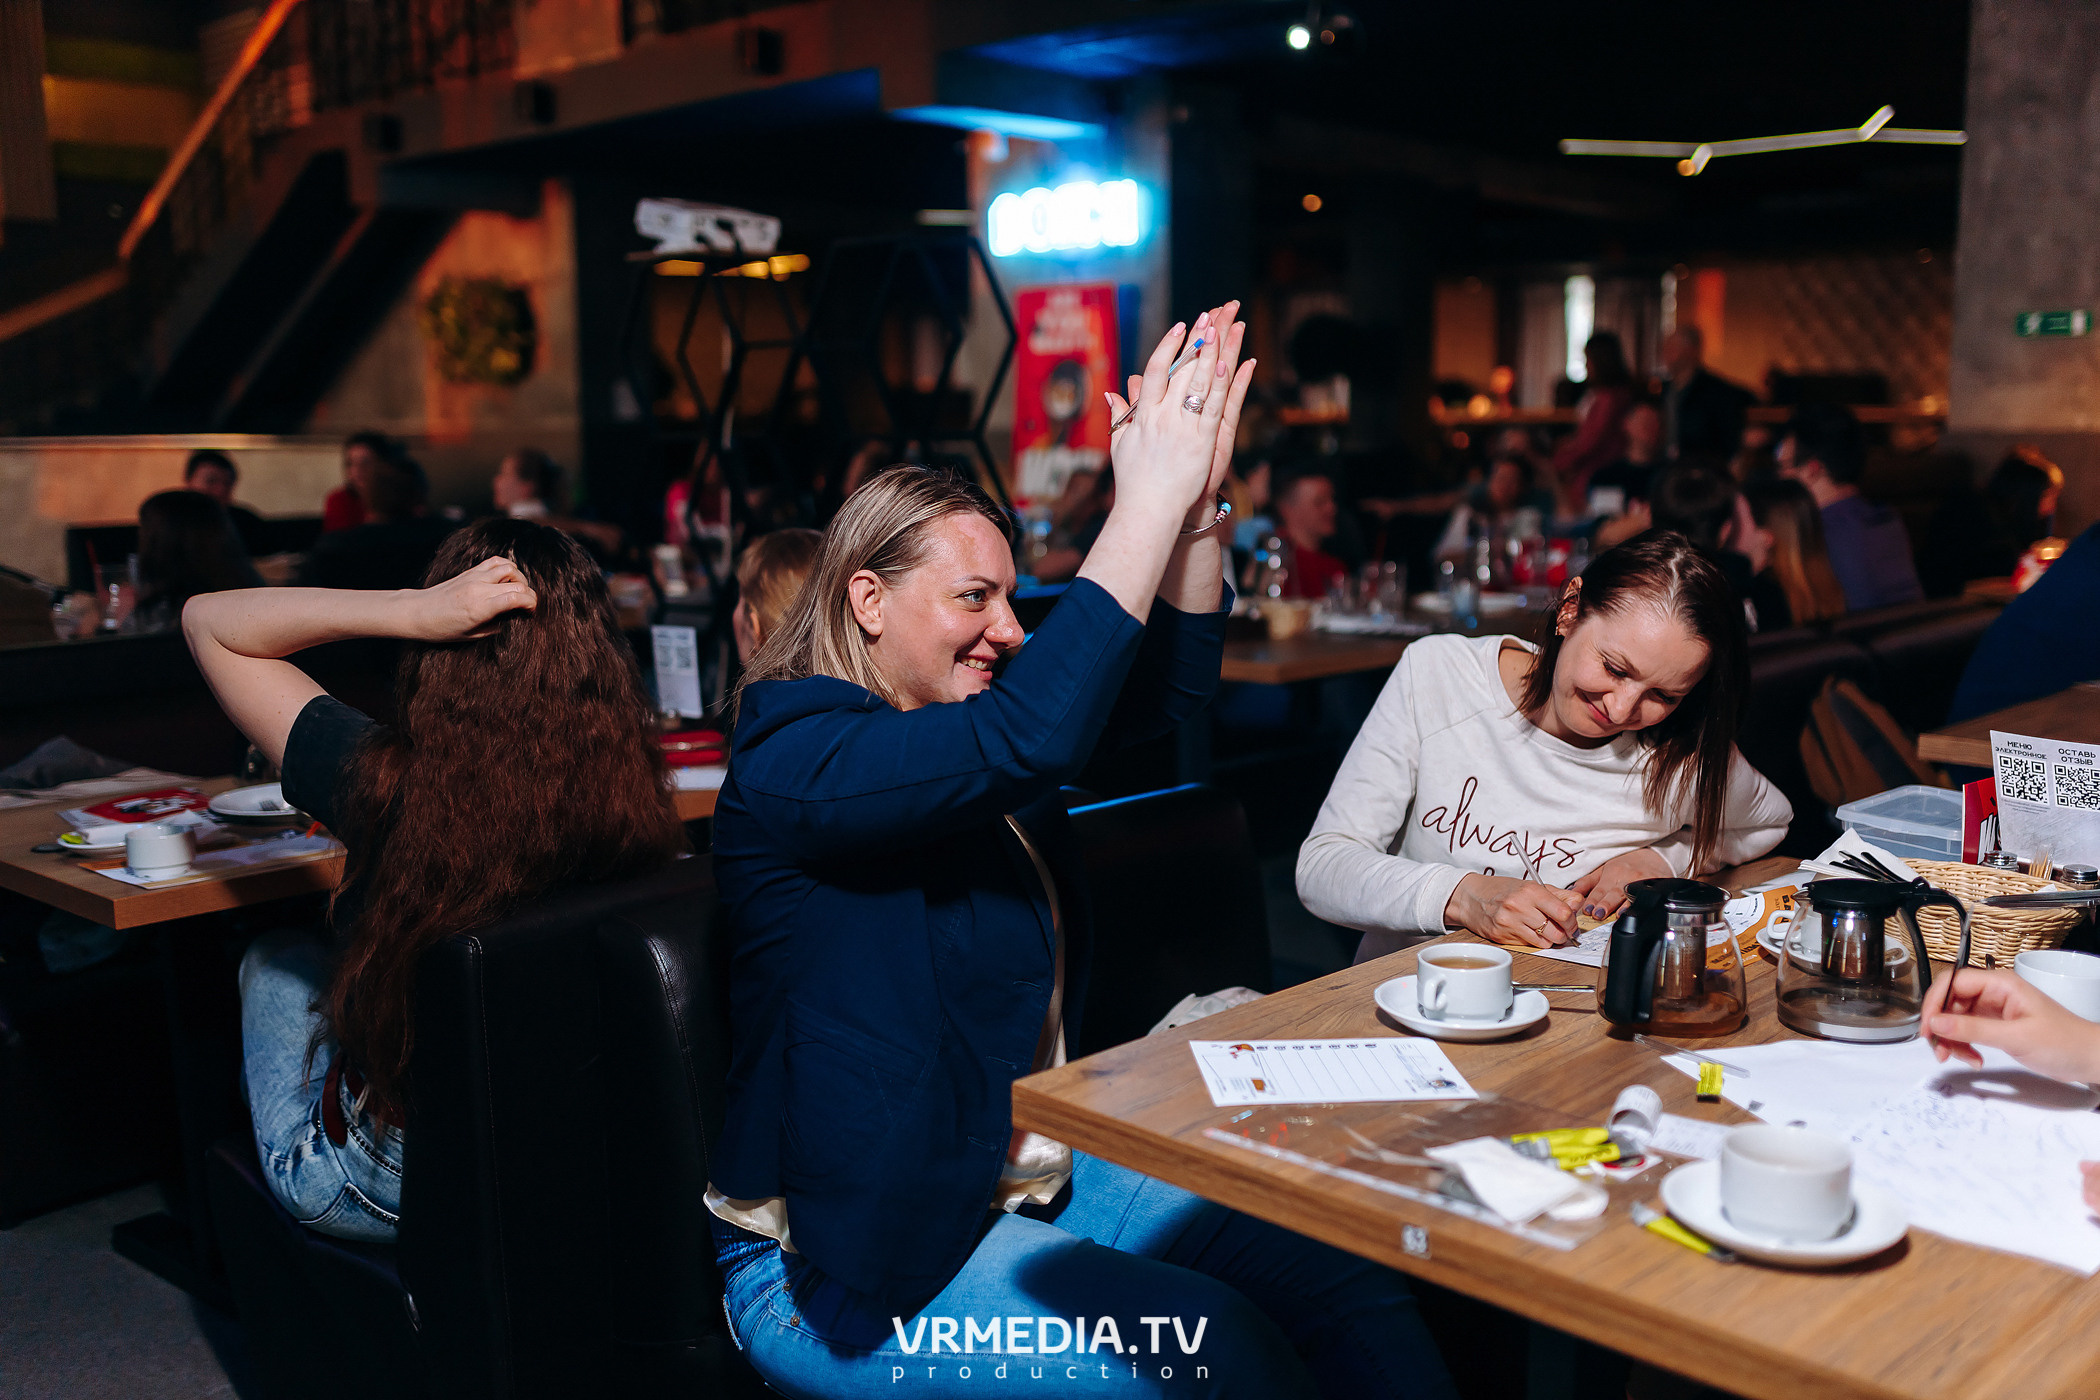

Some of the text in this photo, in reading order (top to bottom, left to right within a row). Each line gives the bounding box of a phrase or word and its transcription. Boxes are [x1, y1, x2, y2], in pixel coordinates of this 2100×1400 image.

[2007, 740, 2033, 751] МЕНЮ
[1995, 746, 2048, 760] ЭЛЕКТРОННОЕ
[2058, 748, 2097, 759] ОСТАВЬ
[2061, 756, 2094, 766] ОТЗЫВ
[1421, 776, 1584, 881] always
